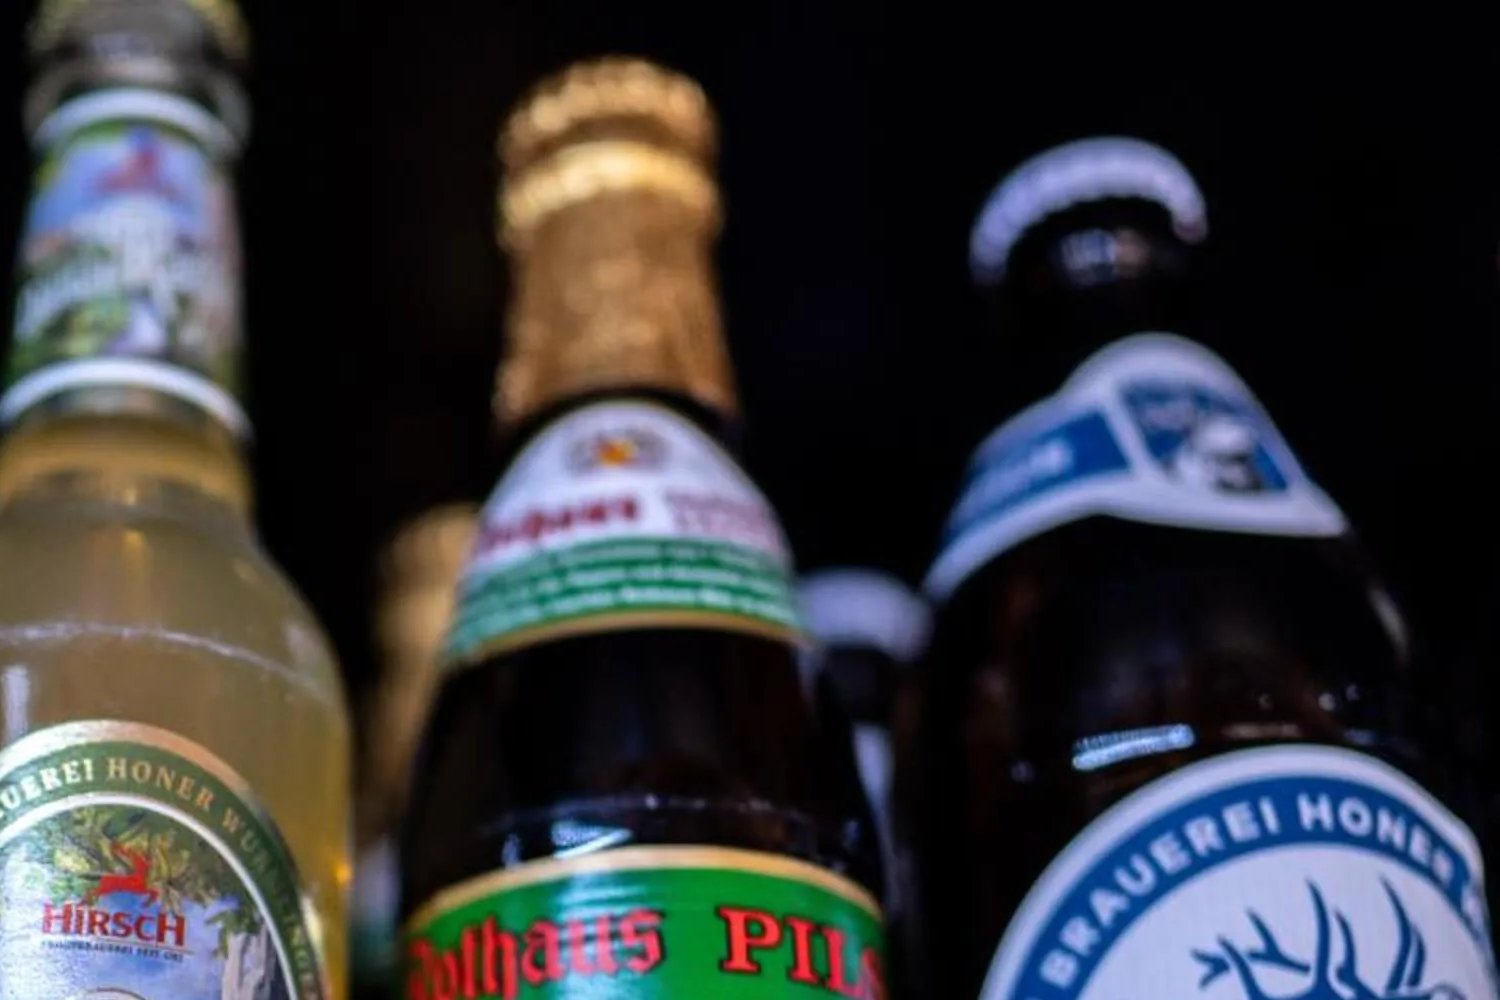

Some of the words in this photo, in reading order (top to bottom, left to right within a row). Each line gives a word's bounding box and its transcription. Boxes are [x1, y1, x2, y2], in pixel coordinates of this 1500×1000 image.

[104, 756, 215, 813] HONER
[1037, 798, 1280, 990] BRAUEREI
[1297, 791, 1454, 894] HONER
[42, 901, 187, 947] HIRSCH
